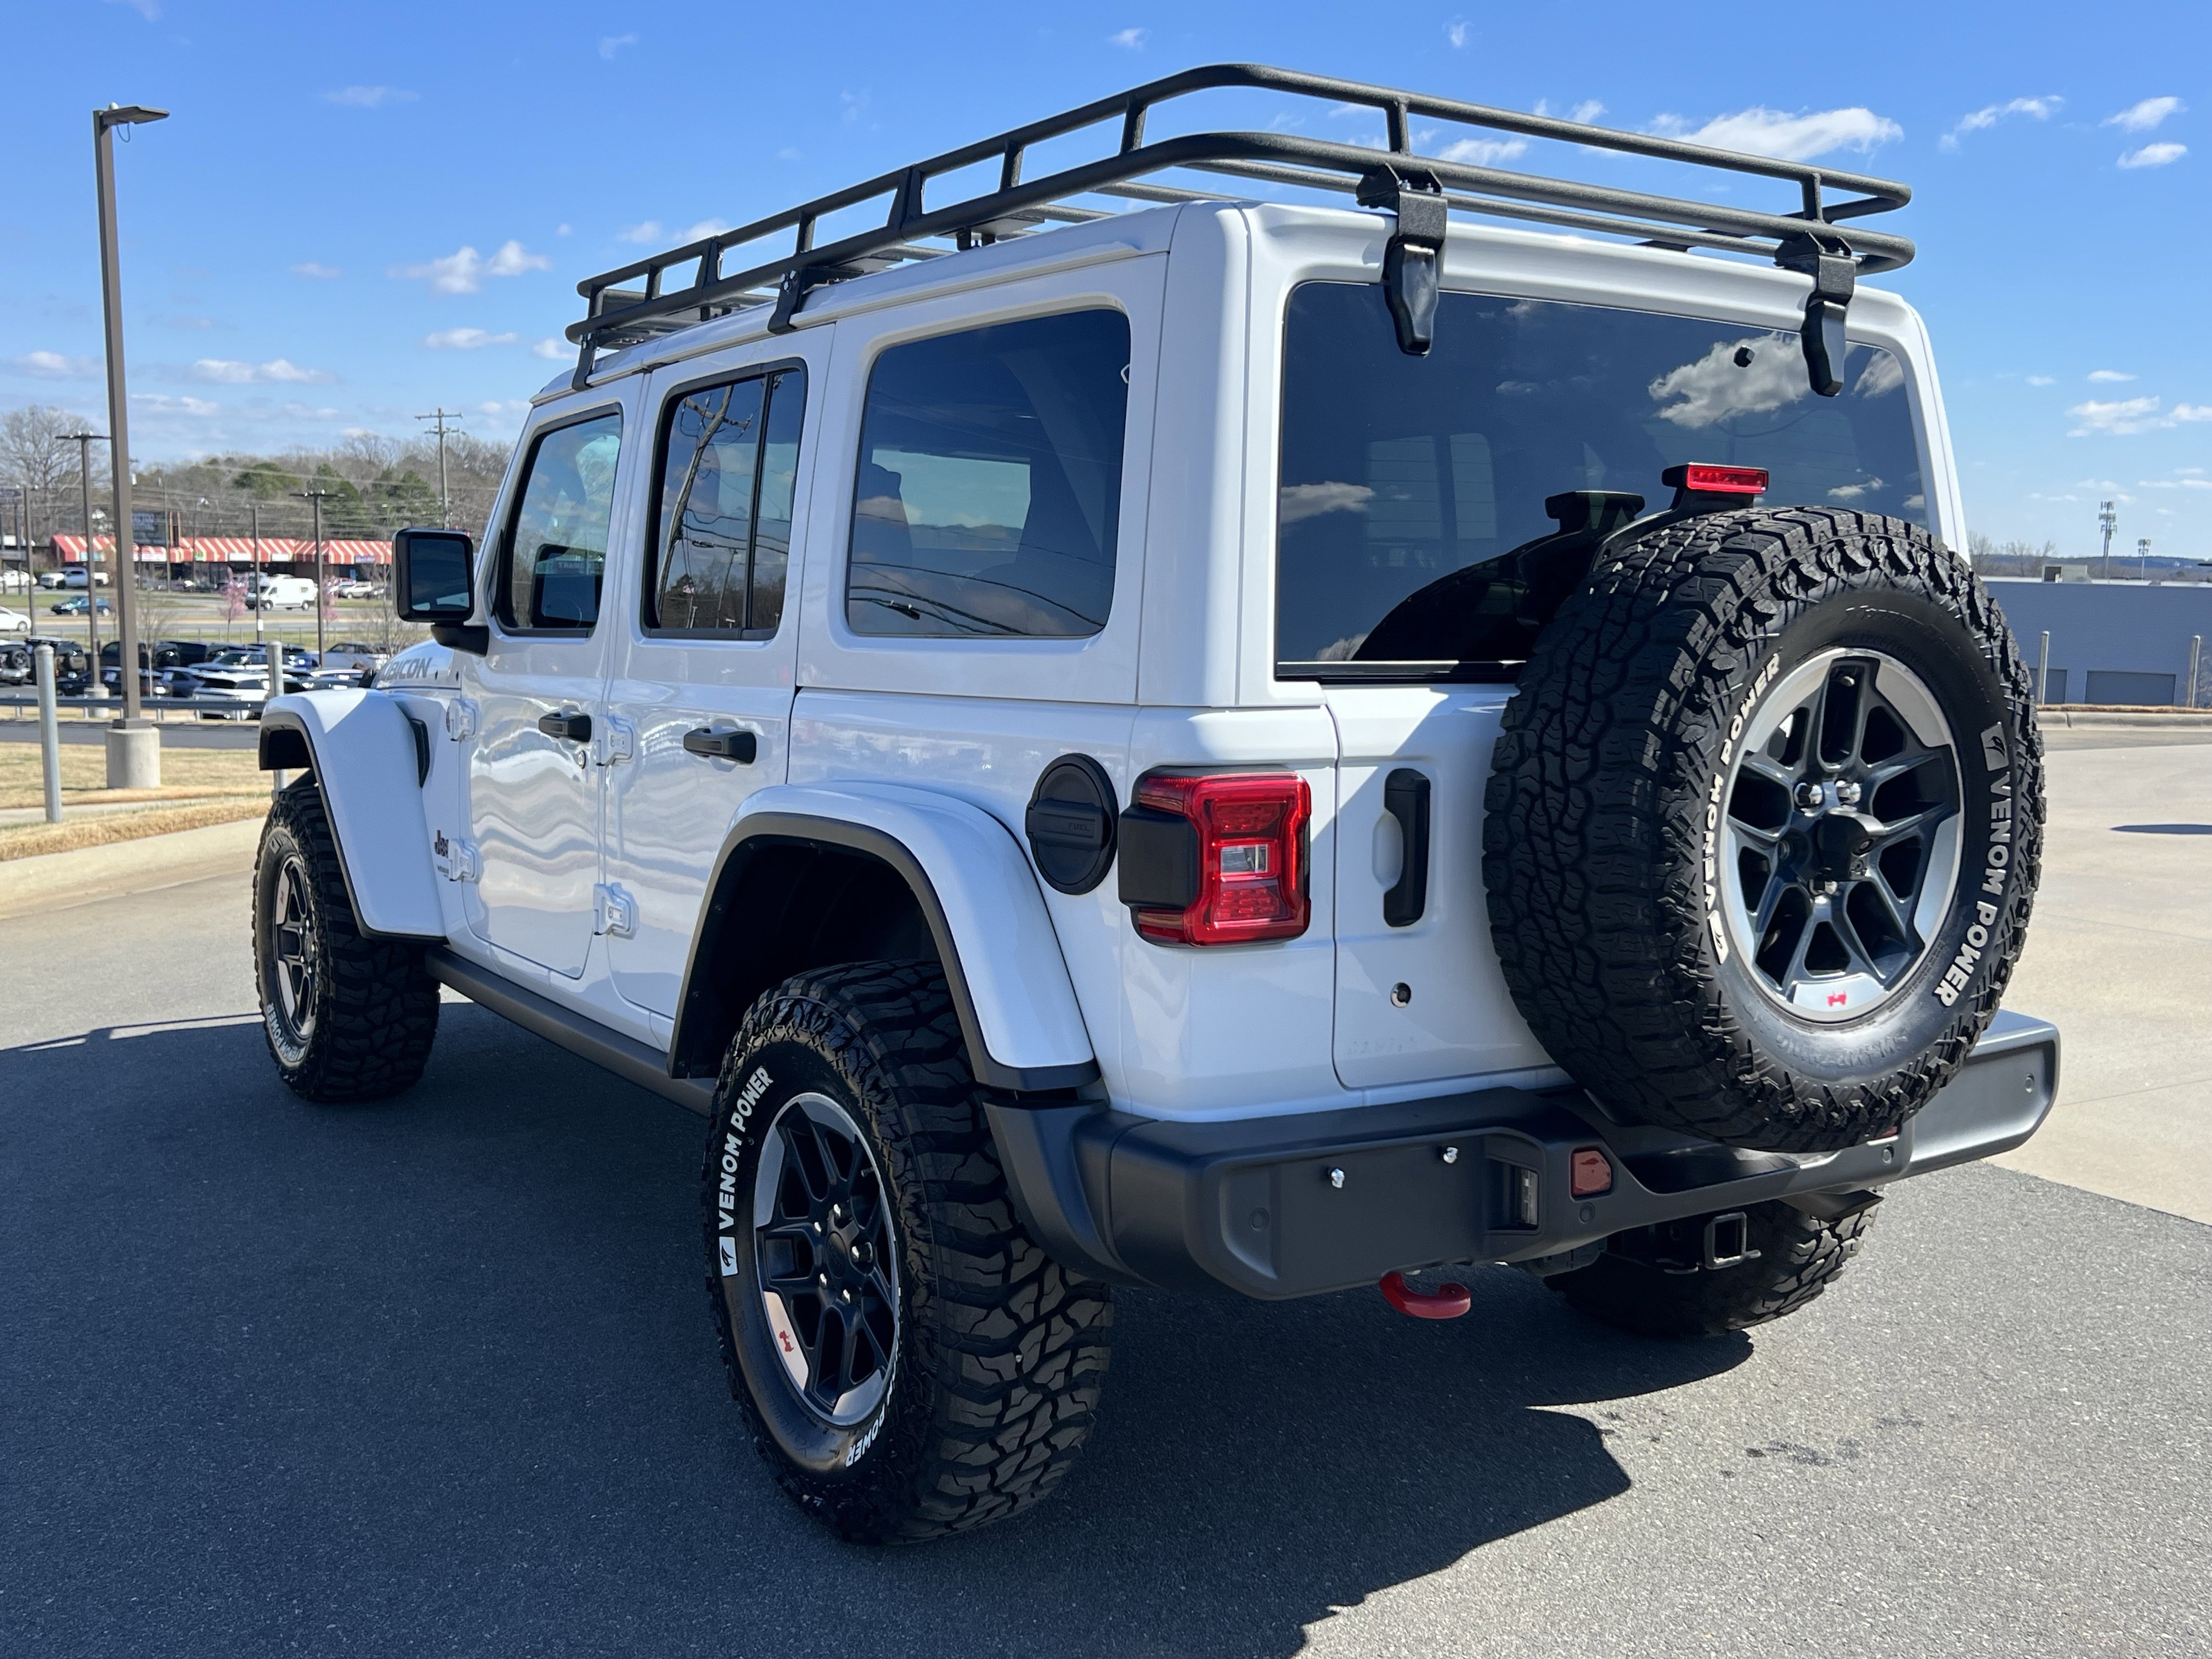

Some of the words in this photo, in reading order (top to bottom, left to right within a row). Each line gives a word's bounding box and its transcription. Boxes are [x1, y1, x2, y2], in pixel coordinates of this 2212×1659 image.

[376, 657, 433, 680] UBICON
[1702, 772, 1724, 911] VENOM
[1720, 652, 1781, 765] POWER
[434, 830, 449, 859] Jee
[1069, 823, 1090, 832] FUEL
[1982, 771, 2012, 896] VENOM
[1933, 900, 1998, 1007] POWER
[718, 1132, 742, 1231] VENOM
[731, 1065, 774, 1133] POWER
[845, 1403, 885, 1468] POWER
